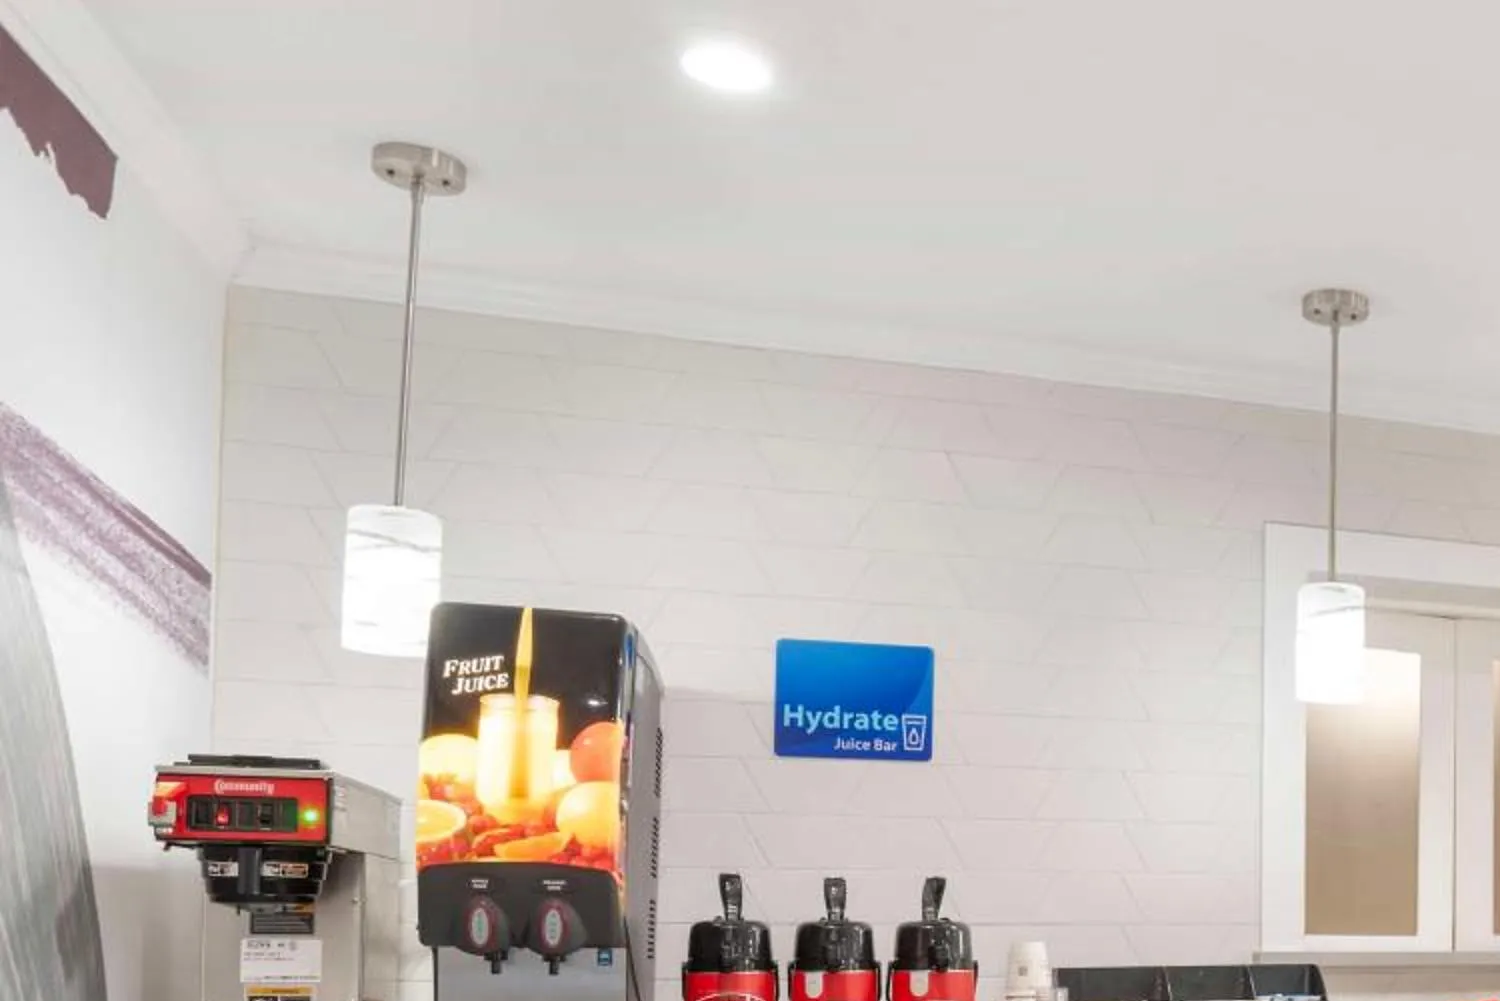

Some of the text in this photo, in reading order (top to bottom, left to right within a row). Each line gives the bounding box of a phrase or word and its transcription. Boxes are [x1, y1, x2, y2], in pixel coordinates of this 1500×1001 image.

[443, 655, 505, 678] FRUIT
[451, 672, 509, 695] JUICE
[783, 703, 900, 735] Hydrate
[834, 737, 897, 752] Juice Bar
